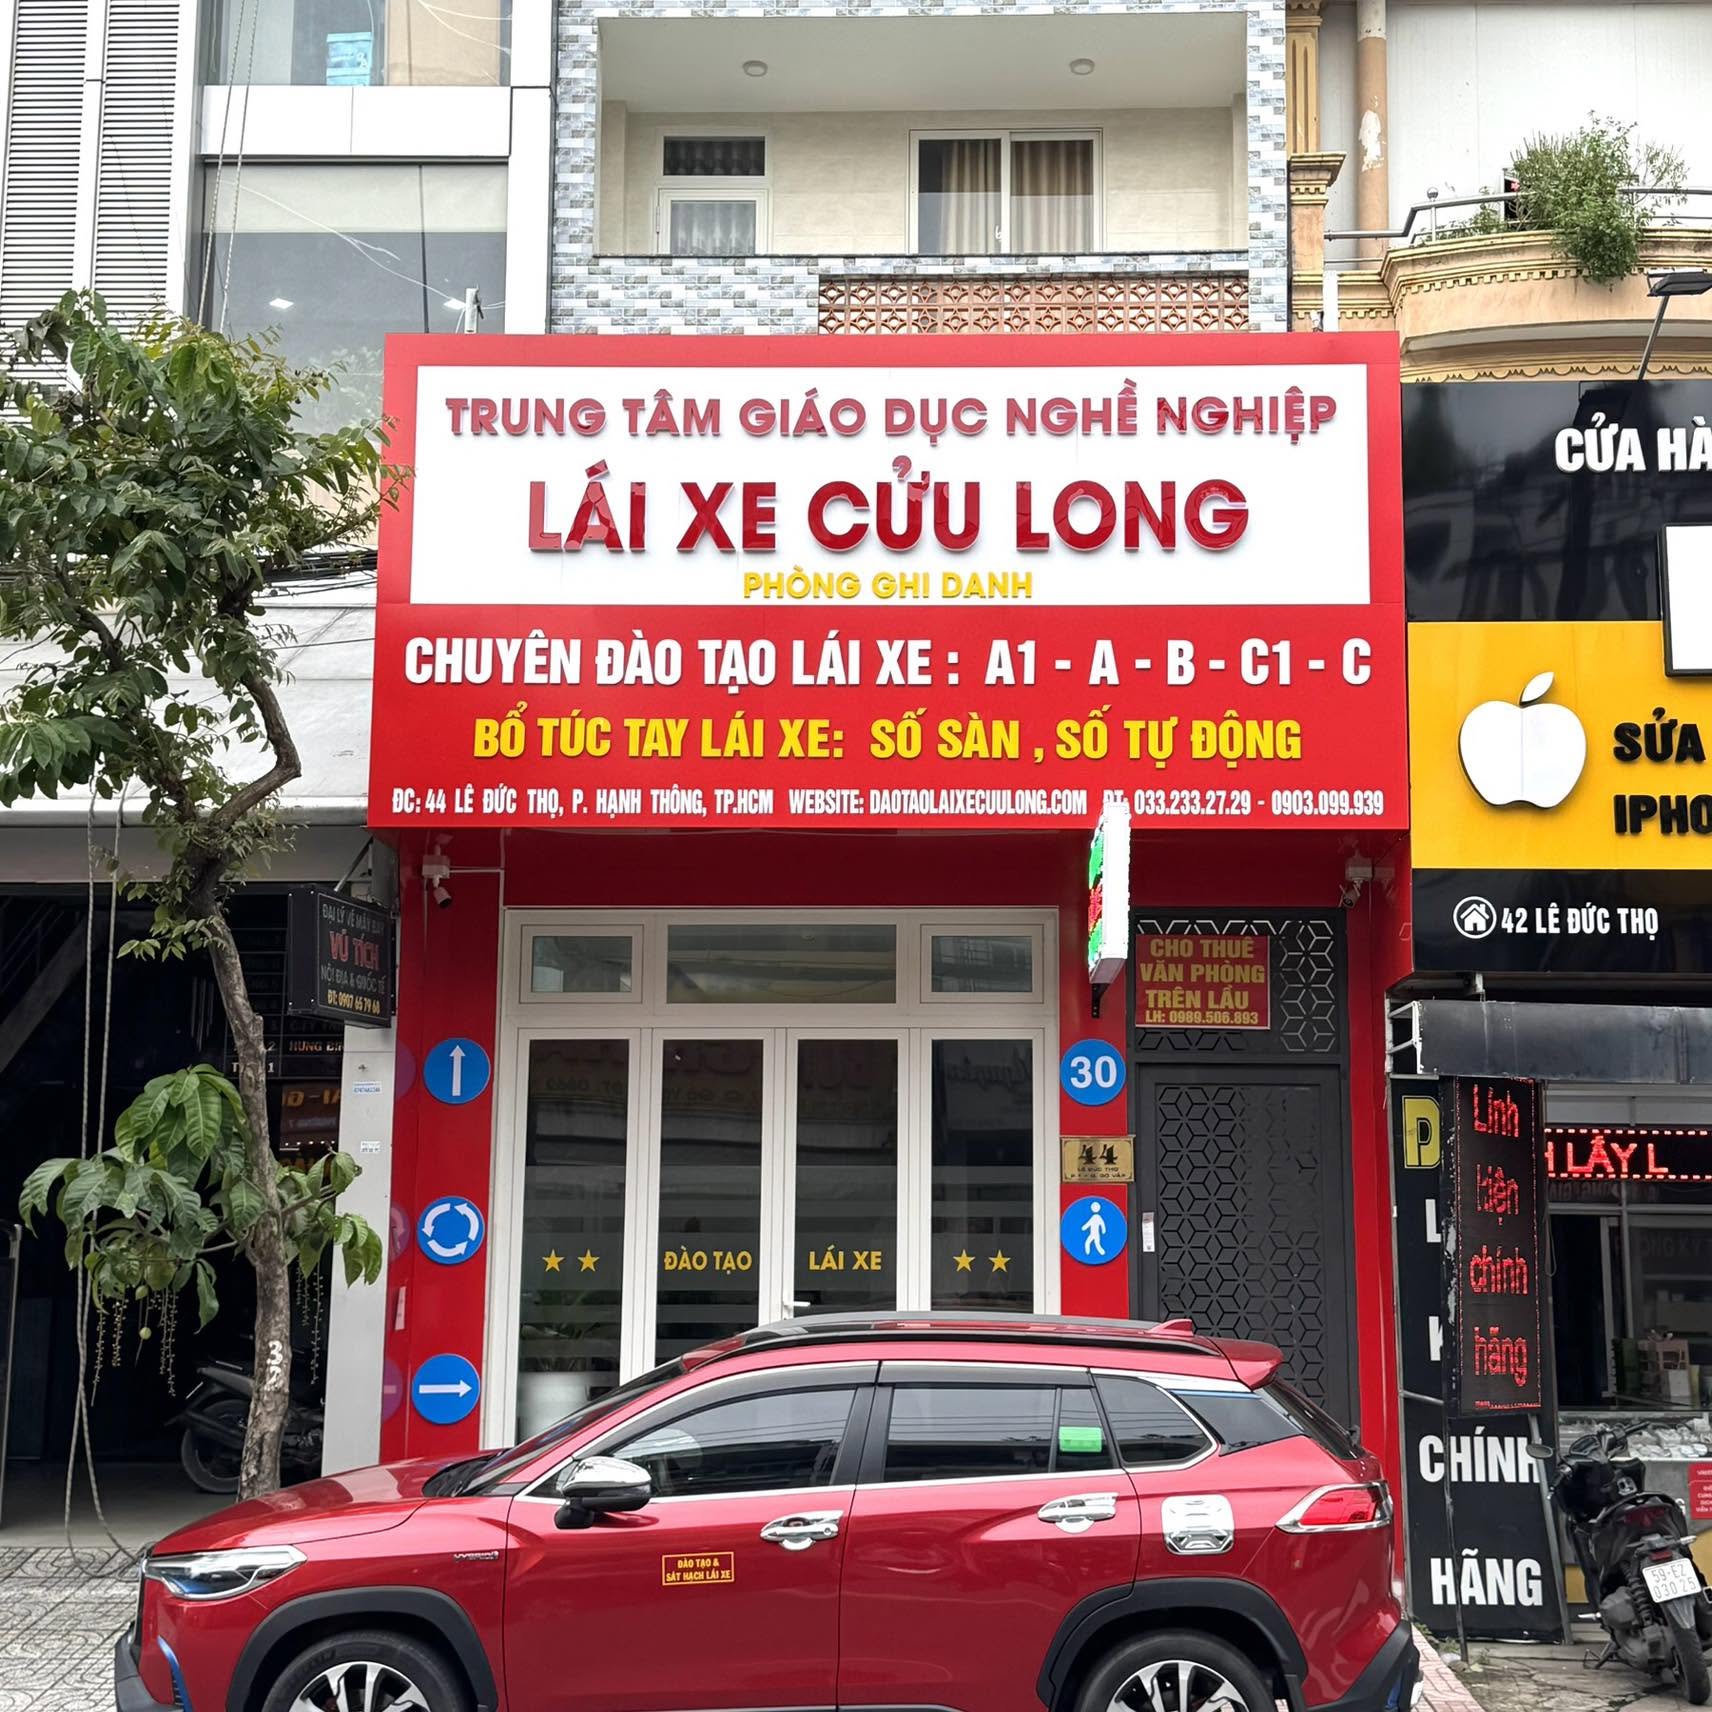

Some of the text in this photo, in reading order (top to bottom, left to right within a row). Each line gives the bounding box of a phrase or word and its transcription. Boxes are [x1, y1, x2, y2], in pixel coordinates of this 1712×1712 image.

[445, 378, 1337, 446] TRUNG TÂM GIÁO DỤC NGHỀ NGHIỆP
[1555, 412, 1712, 472] CỬA HÀ
[528, 455, 1249, 553] LÁI XE CỬU LONG
[743, 566, 1033, 600] PHÒNG GHI DANH
[405, 629, 581, 685] CHUYÊN
[595, 630, 682, 686] ĐÀO
[697, 639, 776, 694] TẠO
[792, 630, 860, 685] LÁI
[875, 639, 932, 685] XE
[984, 639, 1036, 685] A1
[1054, 659, 1071, 670] -
[1088, 639, 1120, 685] A
[1135, 658, 1151, 669] -
[1167, 639, 1195, 685] B
[1208, 659, 1225, 670] -
[1240, 638, 1291, 685] C1
[1308, 659, 1325, 670] -
[1342, 638, 1371, 685] C
[473, 700, 528, 758] BỔ
[537, 709, 611, 758] TÚC
[624, 718, 689, 758] TAY
[701, 711, 764, 758] LÁI
[778, 719, 844, 758] XE:
[870, 708, 927, 759] SỐ
[937, 711, 1020, 759] SÀN
[1055, 705, 1111, 759] SỐ
[1123, 716, 1178, 769] TỰ
[1190, 709, 1301, 768] ĐỘNG
[1613, 707, 1706, 764] SỬA
[392, 787, 421, 814] ĐC:
[425, 788, 446, 814] 44
[454, 784, 475, 813] LÊ
[482, 784, 517, 814] ĐỨC
[527, 788, 564, 819] THỌ,
[572, 788, 588, 814] P.
[596, 788, 642, 819] HẠNH
[650, 784, 707, 817] THÔNG,
[714, 788, 774, 814] TP.HCM
[788, 788, 864, 815] WEBSITE:
[869, 788, 1088, 815] DAOTAOLAIXECUULONG.COM
[1134, 789, 1252, 815] 033.233.27.29
[1271, 789, 1384, 815] 0903.099.939
[1613, 794, 1712, 836] IPHO
[1501, 902, 1659, 941] 42 LÊ ĐỨC THỌ
[1150, 936, 1255, 959] CHO THUÊ
[1139, 959, 1265, 984] VĂN PHÒNG
[1145, 984, 1249, 1010] TRÊN LẦU
[1145, 1010, 1259, 1025] LH: 0989.506.893
[1069, 1055, 1118, 1089] 30
[1078, 1144, 1118, 1165] 44
[663, 1245, 753, 1275] ĐÀO TẠO
[809, 1244, 882, 1271] LÁI XE
[1418, 1426, 1540, 1483] CHÍNH
[695, 1557, 711, 1569] TẠO
[720, 1569, 731, 1579] XE
[1430, 1548, 1543, 1607] HÃNG
